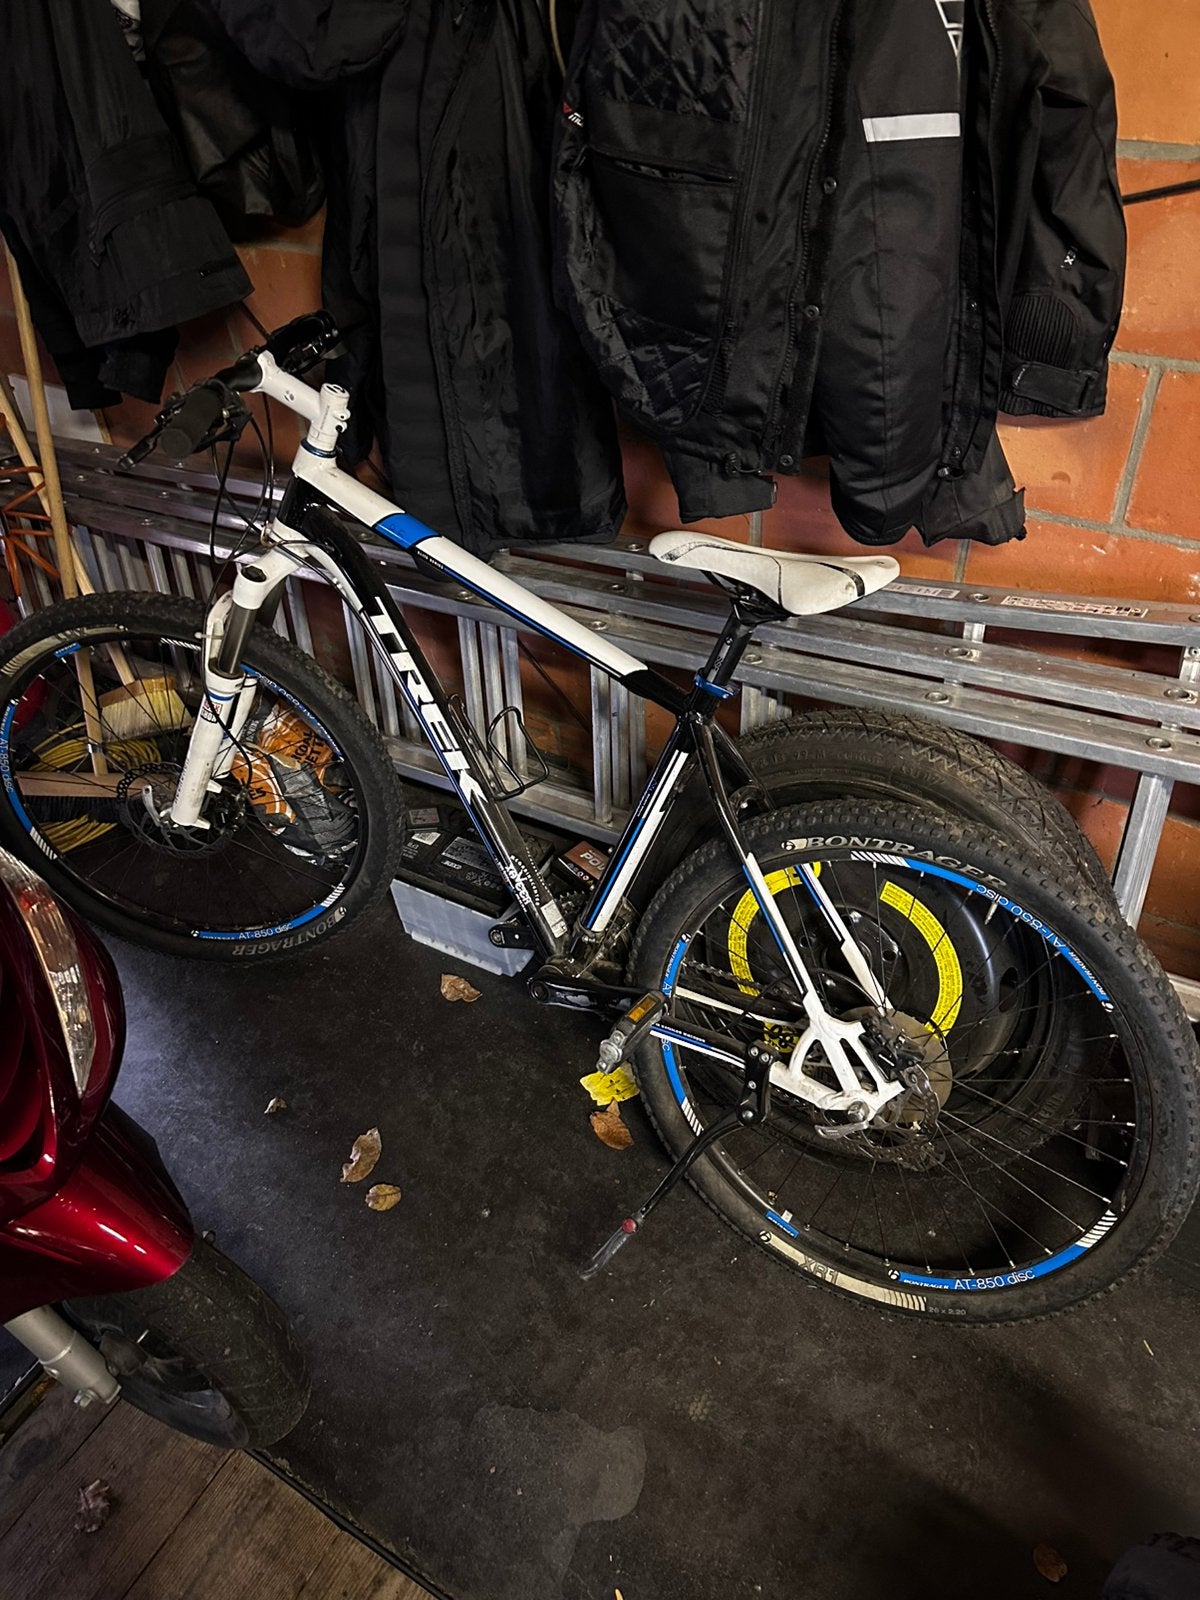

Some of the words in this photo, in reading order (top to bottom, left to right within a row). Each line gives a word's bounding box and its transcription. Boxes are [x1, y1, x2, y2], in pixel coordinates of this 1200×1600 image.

[369, 596, 489, 806] TREK
[805, 836, 1009, 888] BONTRAGER
[975, 883, 1010, 907] disc
[231, 915, 337, 957] BONTRAGER
[238, 929, 274, 940] AT-850
[275, 922, 294, 935] disc
[1011, 903, 1064, 949] AT-850
[800, 1254, 839, 1286] XR1
[903, 1278, 949, 1290] BONTRAGER
[953, 1275, 1005, 1291] AT-850
[1007, 1268, 1036, 1285] disc
